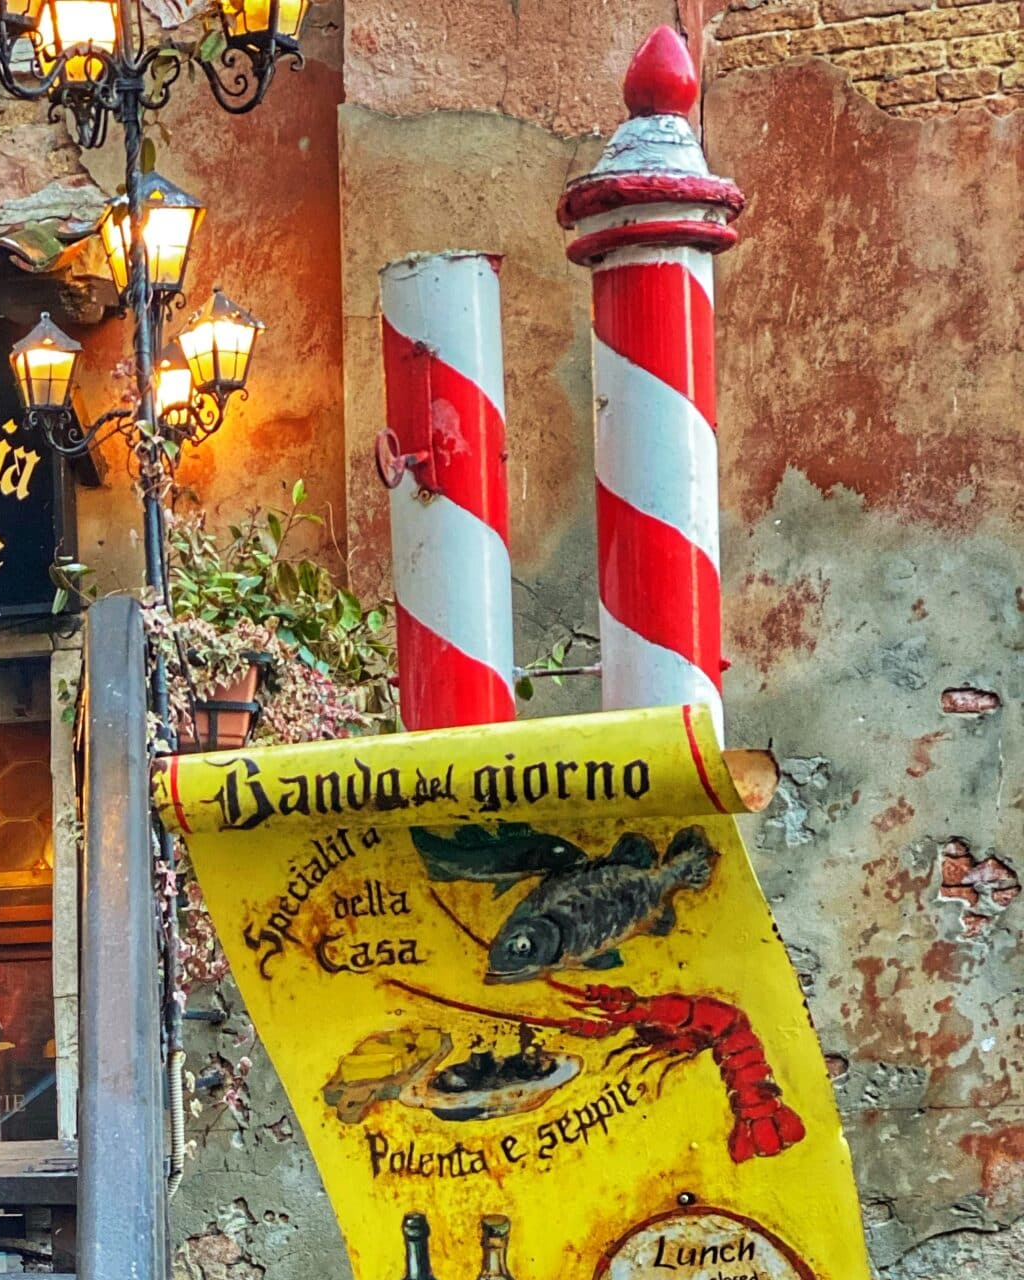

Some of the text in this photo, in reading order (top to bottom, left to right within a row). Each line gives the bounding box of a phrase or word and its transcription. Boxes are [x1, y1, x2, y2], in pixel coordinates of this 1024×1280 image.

[412, 763, 458, 806] del
[473, 752, 650, 812] giorno
[334, 880, 411, 919] della
[315, 931, 426, 974] Casa
[364, 1126, 490, 1179] Polenta
[501, 1134, 526, 1164] e
[653, 1235, 756, 1270] Lunch
